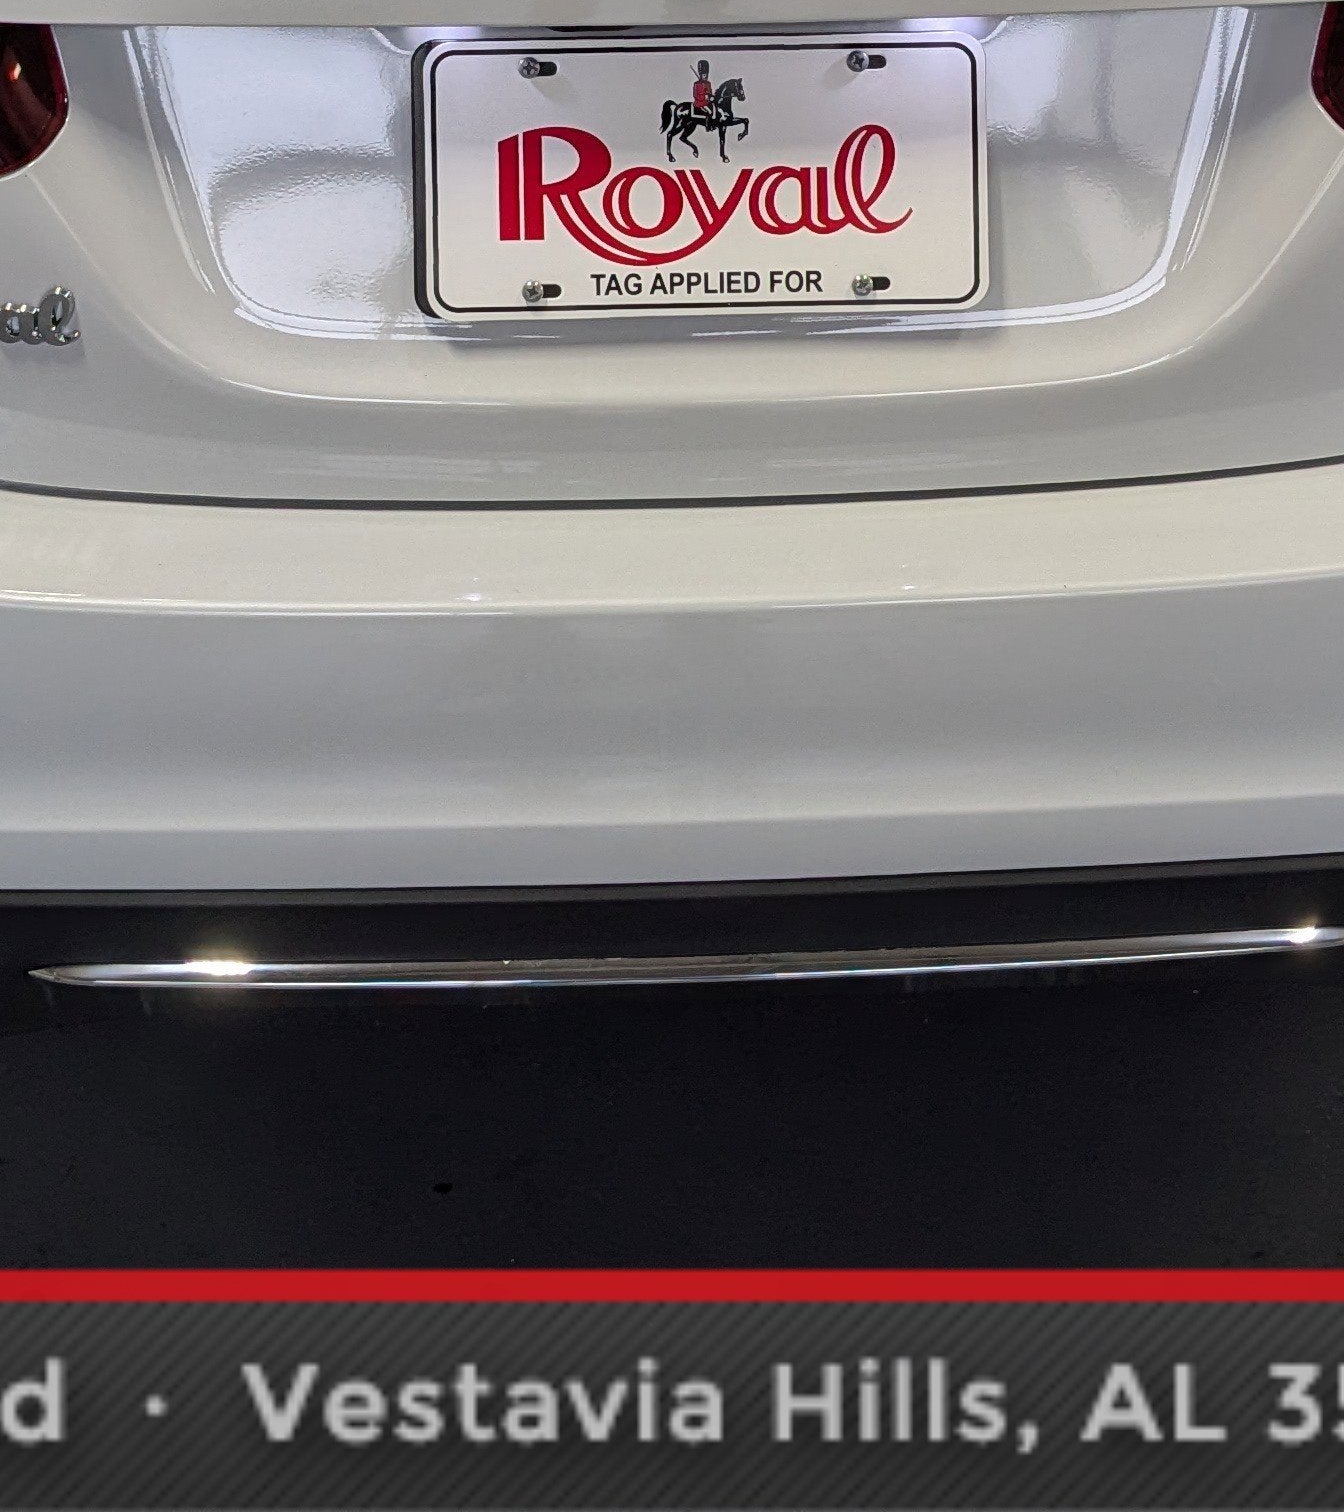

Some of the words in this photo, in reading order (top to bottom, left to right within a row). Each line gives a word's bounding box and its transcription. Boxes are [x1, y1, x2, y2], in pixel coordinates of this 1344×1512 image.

[497, 123, 914, 267] Royal
[589, 273, 644, 296] TAG
[649, 271, 761, 296] APPLIED
[769, 270, 824, 294] FOR
